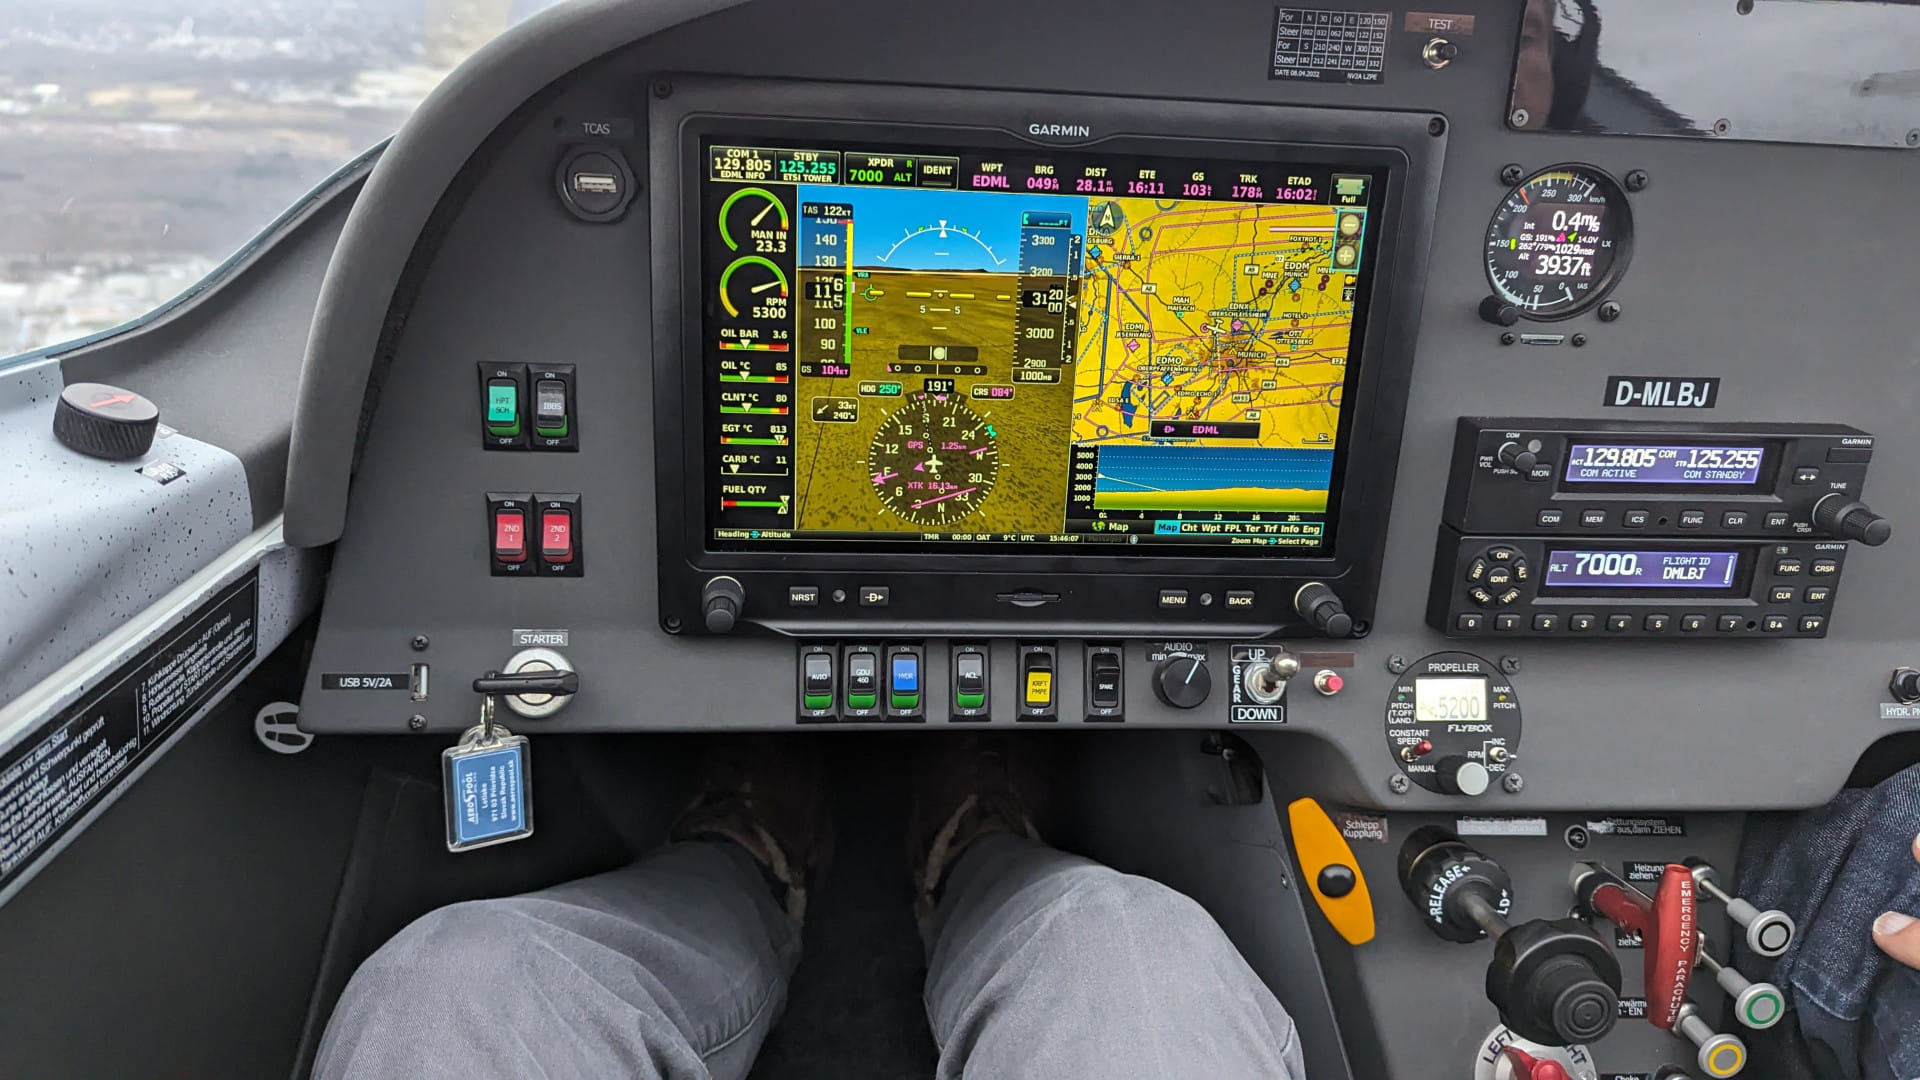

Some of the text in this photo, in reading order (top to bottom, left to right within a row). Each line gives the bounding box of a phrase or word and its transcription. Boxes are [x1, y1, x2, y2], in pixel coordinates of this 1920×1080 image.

[1429, 18, 1453, 30] TEST
[1278, 41, 1290, 50] For
[583, 123, 610, 134] TCAS
[1029, 123, 1090, 137] GARMIN
[728, 149, 750, 158] COM
[794, 152, 819, 162] STBY
[714, 158, 771, 171] 129.805
[780, 161, 836, 174] 125.255
[868, 158, 894, 168] XPDR
[981, 163, 1003, 173] WPT
[923, 165, 952, 176] IDENT
[1035, 165, 1054, 175] BRG
[1085, 168, 1107, 177] DIST
[1139, 170, 1156, 179] ETE
[801, 174, 832, 183] TOWER
[850, 169, 912, 182] 7000 ALT
[1192, 173, 1205, 182] GS
[1240, 174, 1258, 184] TRK
[972, 175, 1010, 188] EDML
[1287, 176, 1311, 186] ETAD
[1127, 182, 1165, 195] 16:11
[1342, 195, 1357, 204] Full
[1513, 205, 1527, 213] 200
[751, 230, 787, 240] MAN IN
[815, 234, 837, 245] 140
[1032, 234, 1055, 246] 3300
[756, 240, 786, 252] 23.3
[815, 255, 837, 267] 130
[1284, 262, 1310, 271] EDDM
[766, 298, 787, 307] RPM
[753, 307, 786, 319] 5300
[814, 318, 836, 329] 100
[1125, 323, 1144, 332] EDMJ
[721, 328, 787, 339] OIL BAR 3.6
[1156, 356, 1182, 365] EDMO
[722, 393, 787, 403] CLNT 80
[1615, 381, 1710, 406] D-MLBJ
[1192, 426, 1219, 434] EDML
[722, 455, 786, 464] CARB 11
[1584, 448, 1657, 467] 129.805
[1687, 450, 1760, 468] 125.255
[1581, 469, 1637, 477] COM ACTIVE
[722, 485, 766, 495] FUEL QTY
[1108, 522, 1128, 532] Map
[1158, 523, 1320, 535] Map Cht Wpt FPL Ter Trf Info Eng
[717, 530, 791, 540] Heading Altitude
[1254, 538, 1268, 546] Map
[1301, 539, 1319, 547] Page
[1575, 553, 1637, 575] 7000
[1663, 568, 1706, 580] DMLBJ
[520, 634, 564, 644] STARTER
[1164, 642, 1193, 651] AUDIO
[1248, 649, 1265, 660] UP
[1428, 664, 1479, 672] PROPELLER
[340, 678, 392, 688] USB 5V/2A
[1232, 665, 1241, 703] GEAR
[1238, 708, 1277, 720] DOWN
[1346, 820, 1379, 829] Schlepp
[1343, 828, 1382, 839] Kupplung
[1429, 865, 1463, 916] RELEASE
[1667, 881, 1691, 1022] EMERGENCY PARACHUTE
[1628, 1007, 1642, 1016] EIN
[1483, 1029, 1514, 1064] LEFT
